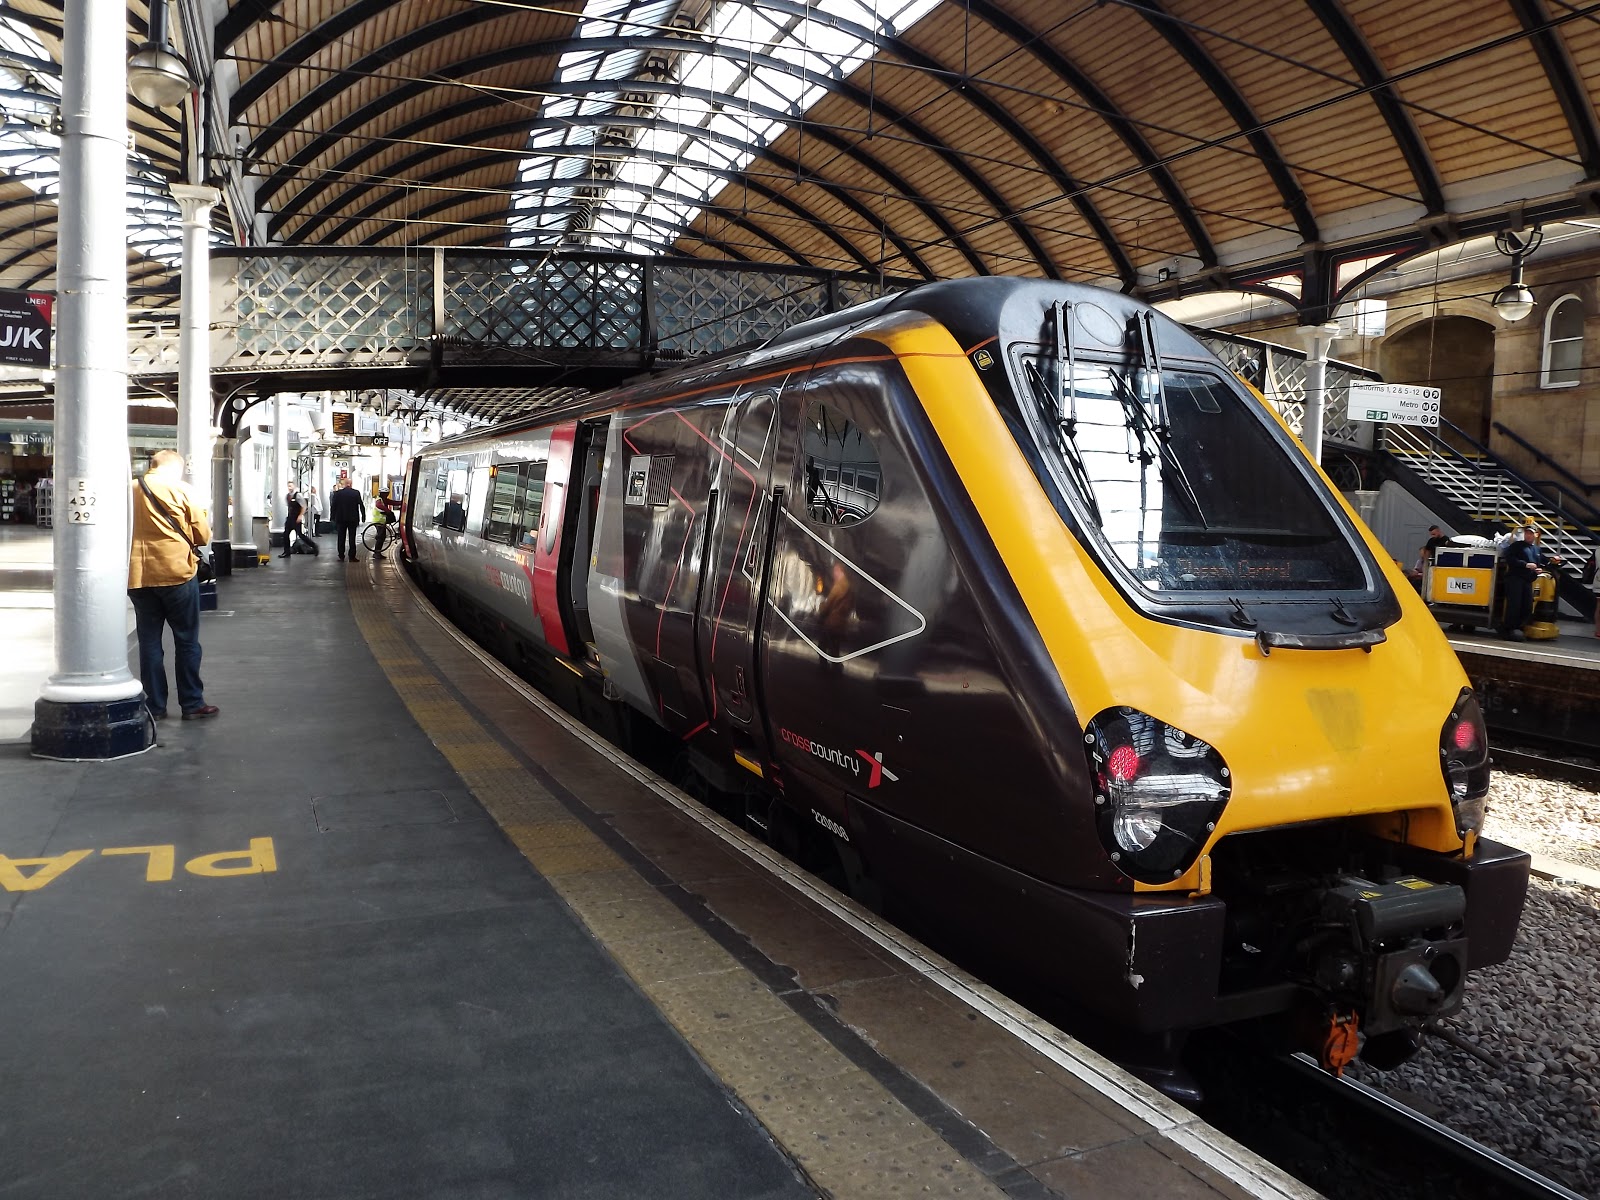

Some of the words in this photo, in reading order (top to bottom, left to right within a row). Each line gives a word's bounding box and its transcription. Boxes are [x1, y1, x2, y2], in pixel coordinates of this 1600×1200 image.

[0, 326, 43, 350] J/K
[1353, 383, 1385, 392] Platforms
[1391, 412, 1406, 421] Way
[79, 481, 85, 491] E
[70, 496, 96, 506] 432
[74, 511, 90, 521] 29
[1450, 581, 1473, 590] LNER
[781, 727, 860, 777] crosscountry
